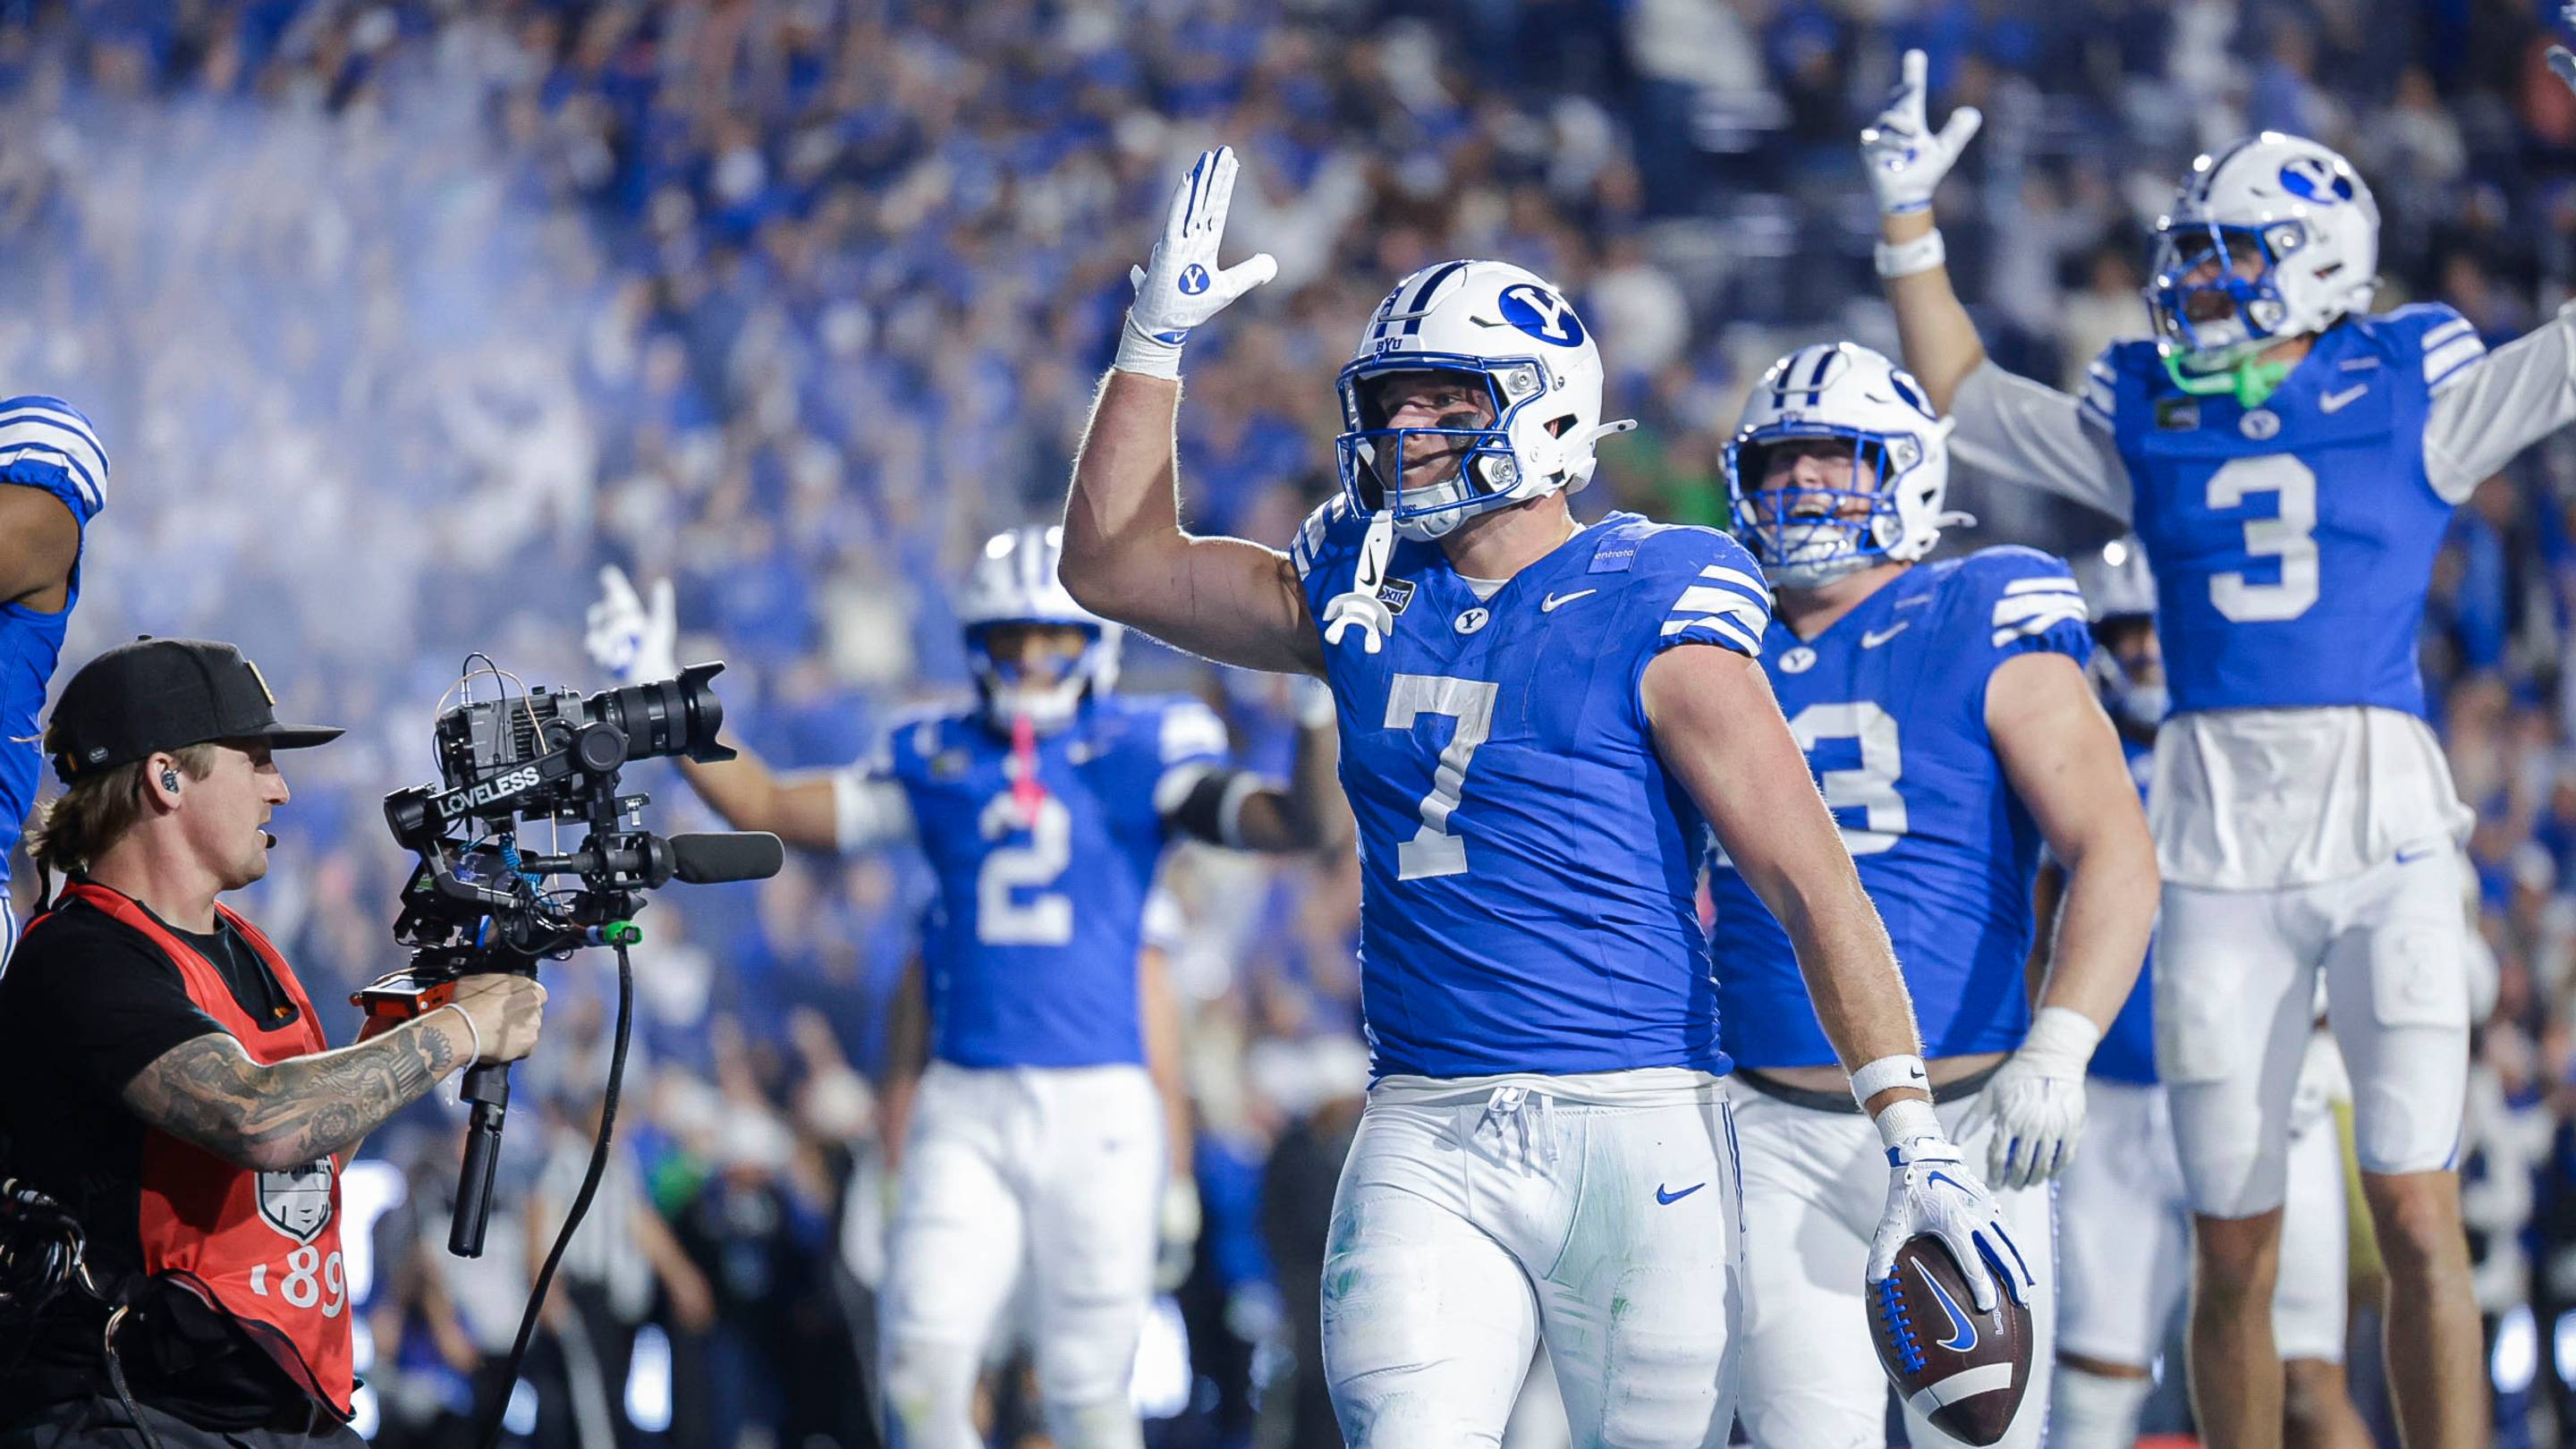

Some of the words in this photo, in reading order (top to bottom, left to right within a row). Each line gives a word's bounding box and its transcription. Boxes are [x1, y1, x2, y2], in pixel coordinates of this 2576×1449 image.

[1183, 266, 1204, 293] Y
[1508, 287, 1573, 340] Y
[1376, 336, 1402, 352] BYU
[1595, 549, 1634, 559] entrata
[2206, 453, 2319, 623] 3
[1462, 611, 1484, 630] Y
[436, 767, 540, 818] LOVELESS
[1383, 673, 1499, 881] 7
[977, 791, 1072, 946] 2
